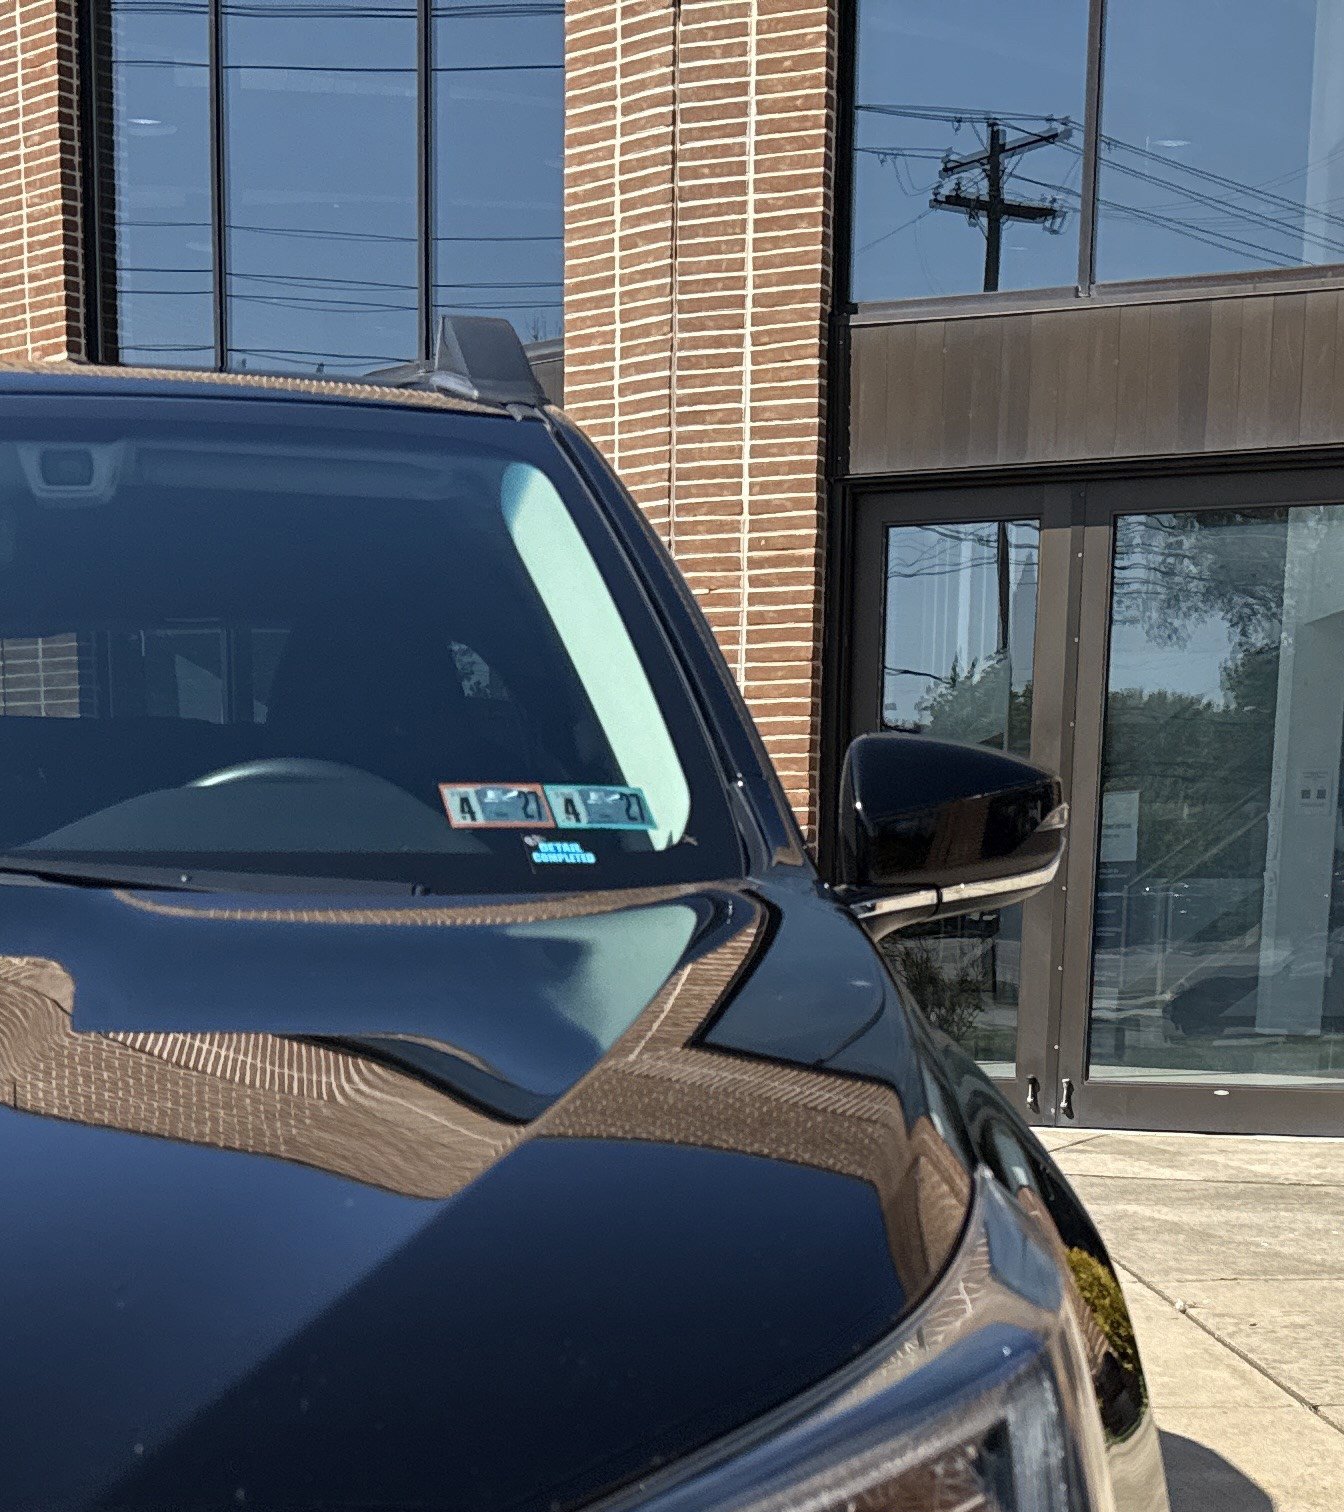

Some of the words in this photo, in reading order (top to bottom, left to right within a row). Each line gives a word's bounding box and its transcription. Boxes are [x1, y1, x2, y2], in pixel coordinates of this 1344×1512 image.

[459, 796, 477, 823] 4
[517, 790, 543, 821] 27
[563, 797, 582, 824] 4
[619, 792, 645, 823] 27
[532, 852, 596, 864] COMPLETED
